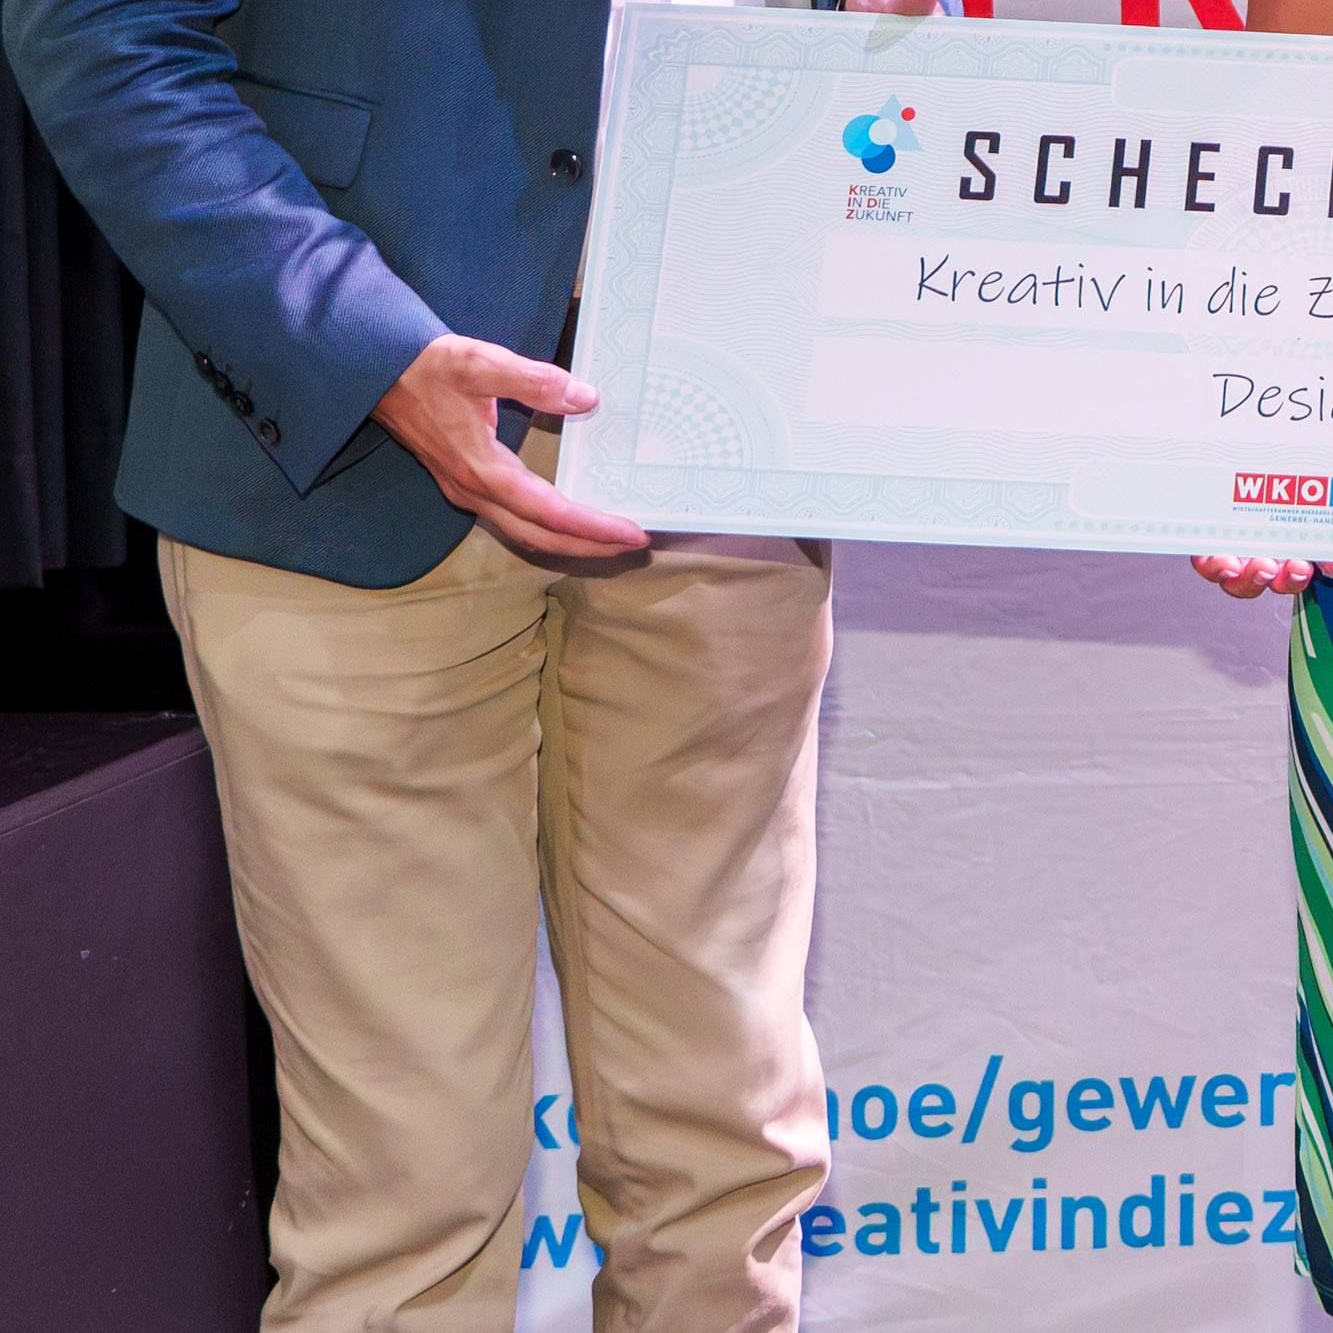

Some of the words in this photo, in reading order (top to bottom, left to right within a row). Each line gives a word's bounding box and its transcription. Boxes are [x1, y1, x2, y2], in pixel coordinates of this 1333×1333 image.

[848, 184, 908, 198] KREATIV
[847, 196, 863, 208] IN
[867, 197, 891, 210] DIE
[846, 208, 914, 223] ZUKUNFT
[916, 253, 1127, 313] Kreativ
[1145, 267, 1184, 315] in
[1205, 265, 1282, 318] die
[1235, 475, 1325, 503] WKO
